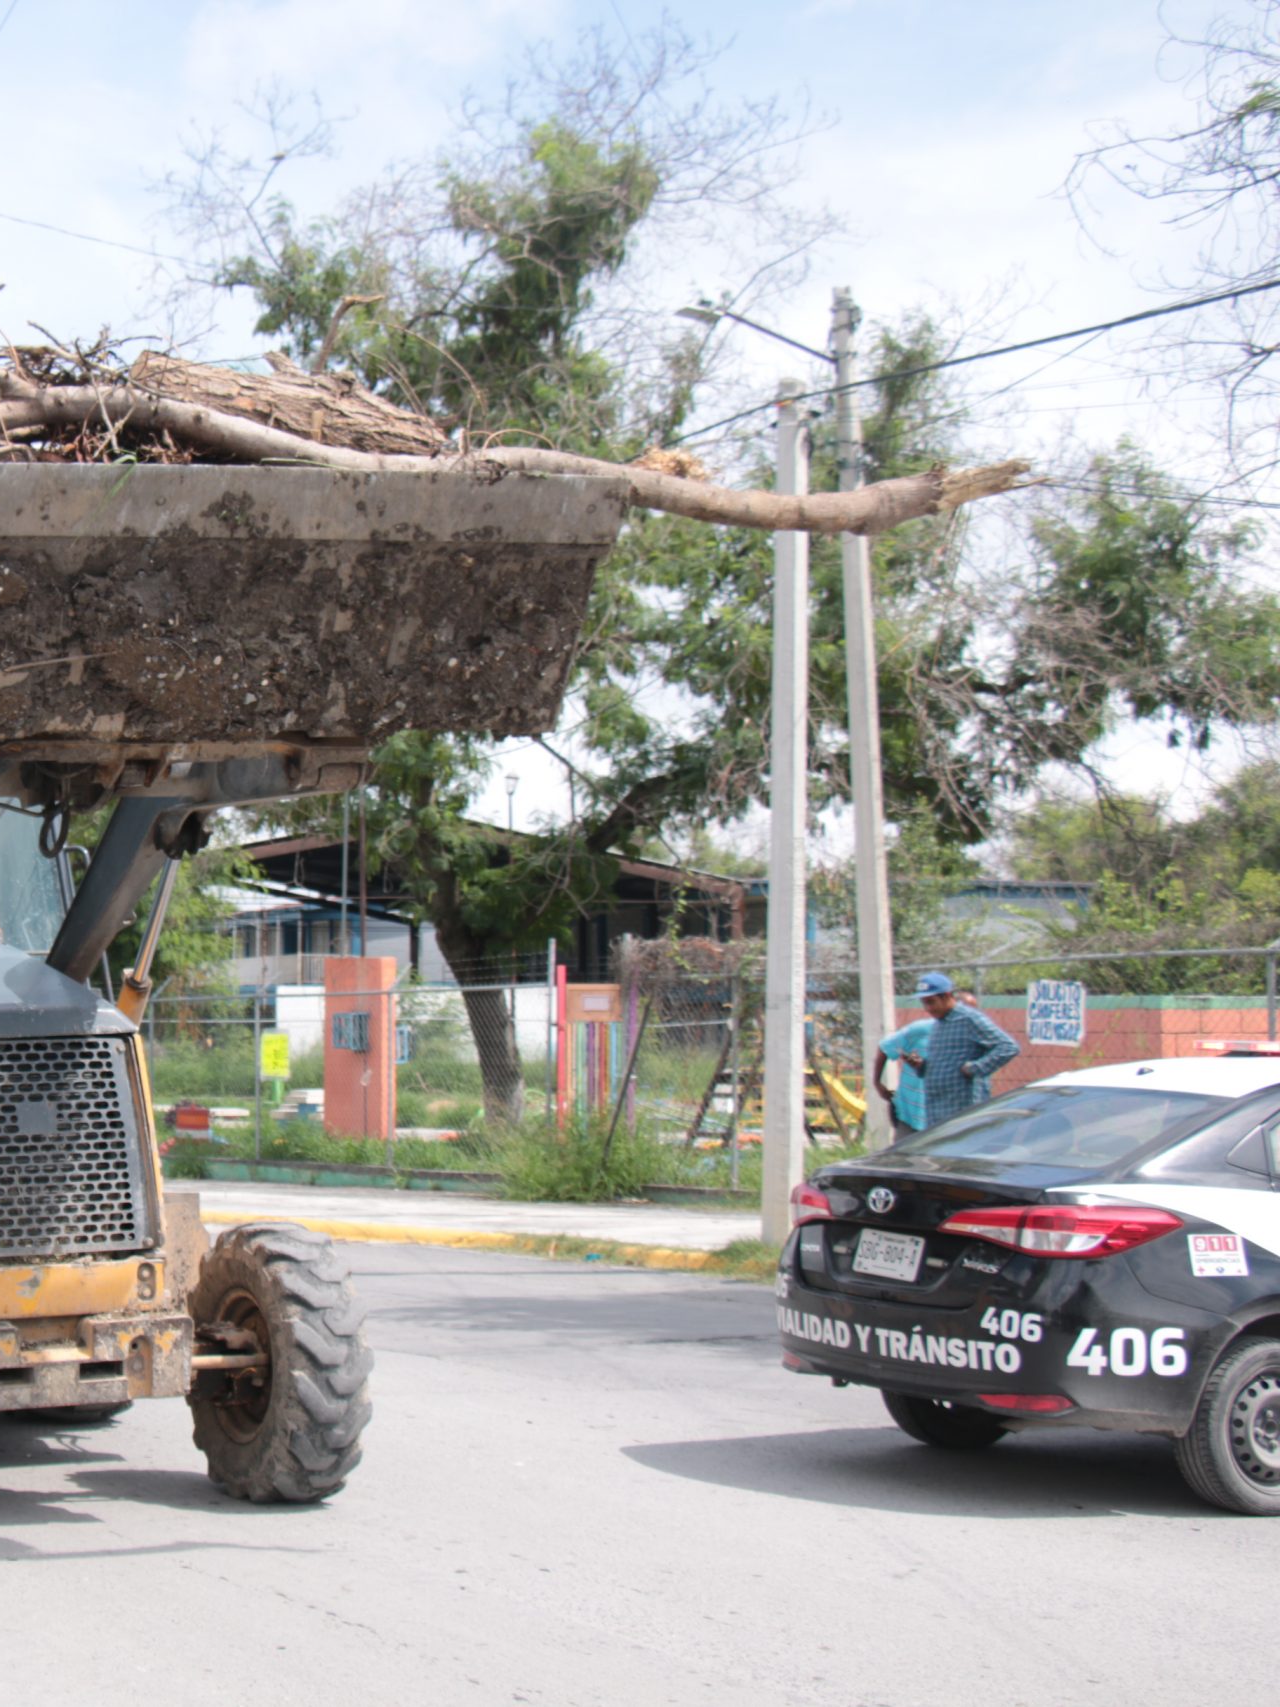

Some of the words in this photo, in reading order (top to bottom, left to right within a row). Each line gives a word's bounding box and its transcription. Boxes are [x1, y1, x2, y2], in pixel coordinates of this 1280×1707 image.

[1193, 1236, 1238, 1251] 911
[980, 1306, 1042, 1343] 406
[854, 1323, 871, 1353] Y
[875, 1325, 1021, 1373] TRÁNSITO
[1066, 1327, 1187, 1376] 406
